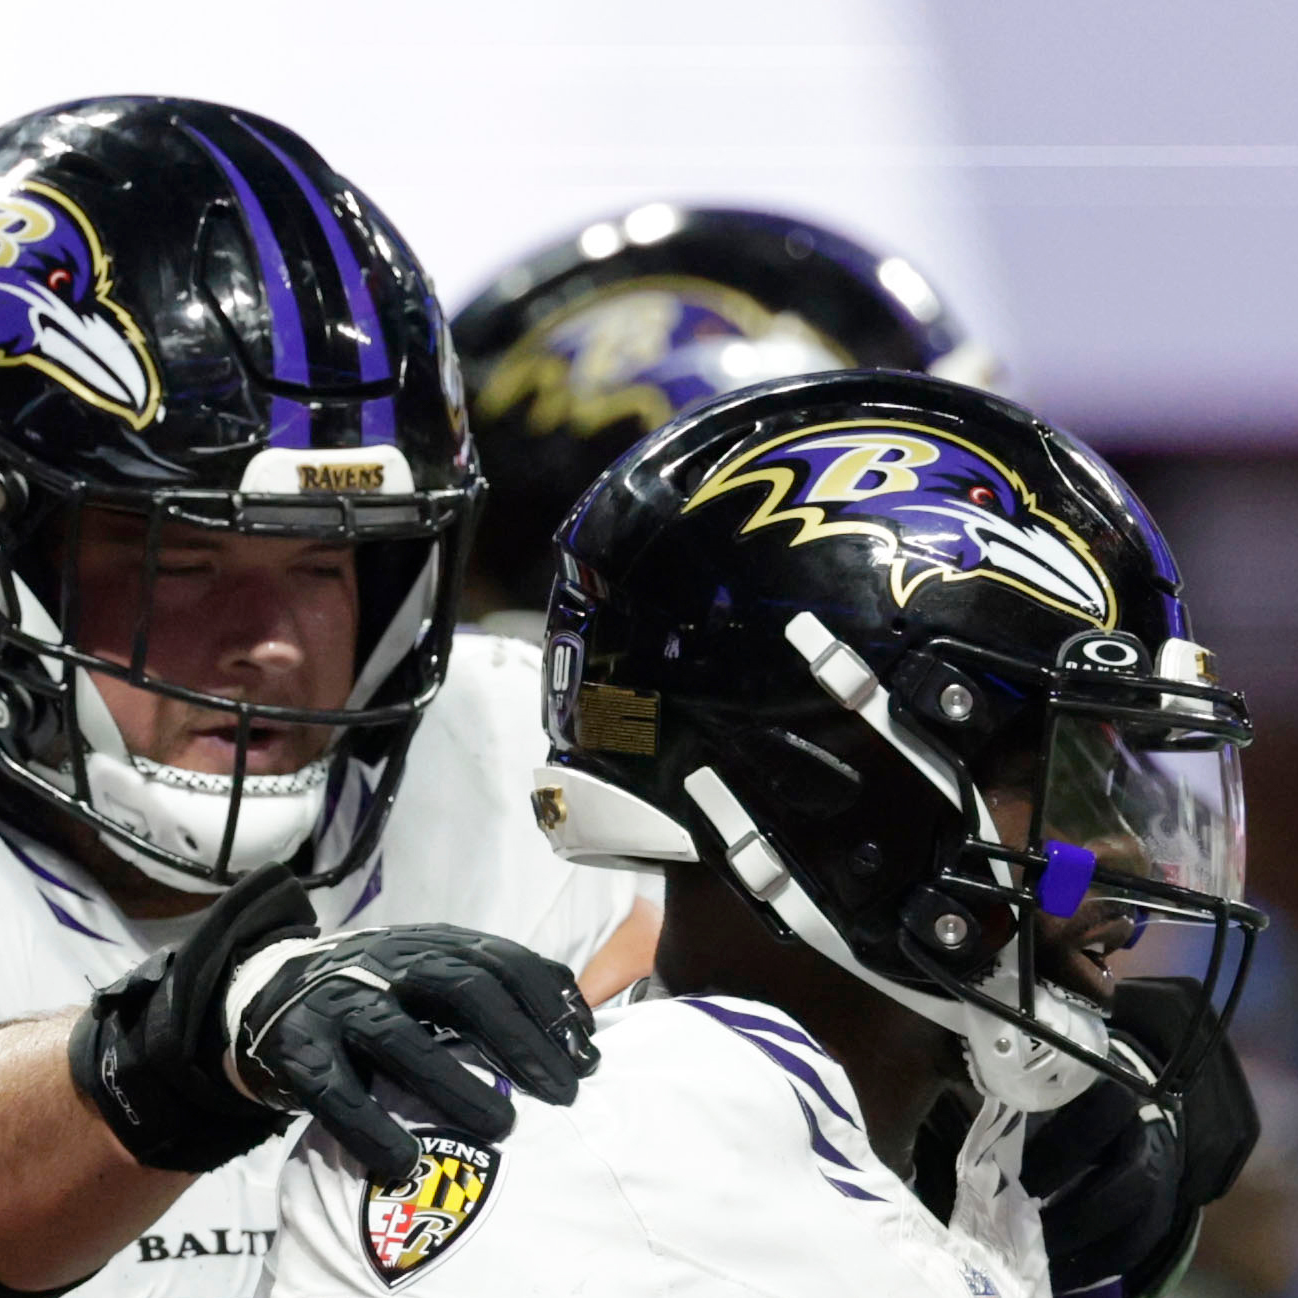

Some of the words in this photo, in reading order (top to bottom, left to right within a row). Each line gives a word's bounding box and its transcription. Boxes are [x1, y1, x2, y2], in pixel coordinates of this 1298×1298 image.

[298, 464, 384, 489] RAVENS
[784, 433, 942, 503] B
[420, 1136, 491, 1169] VENS
